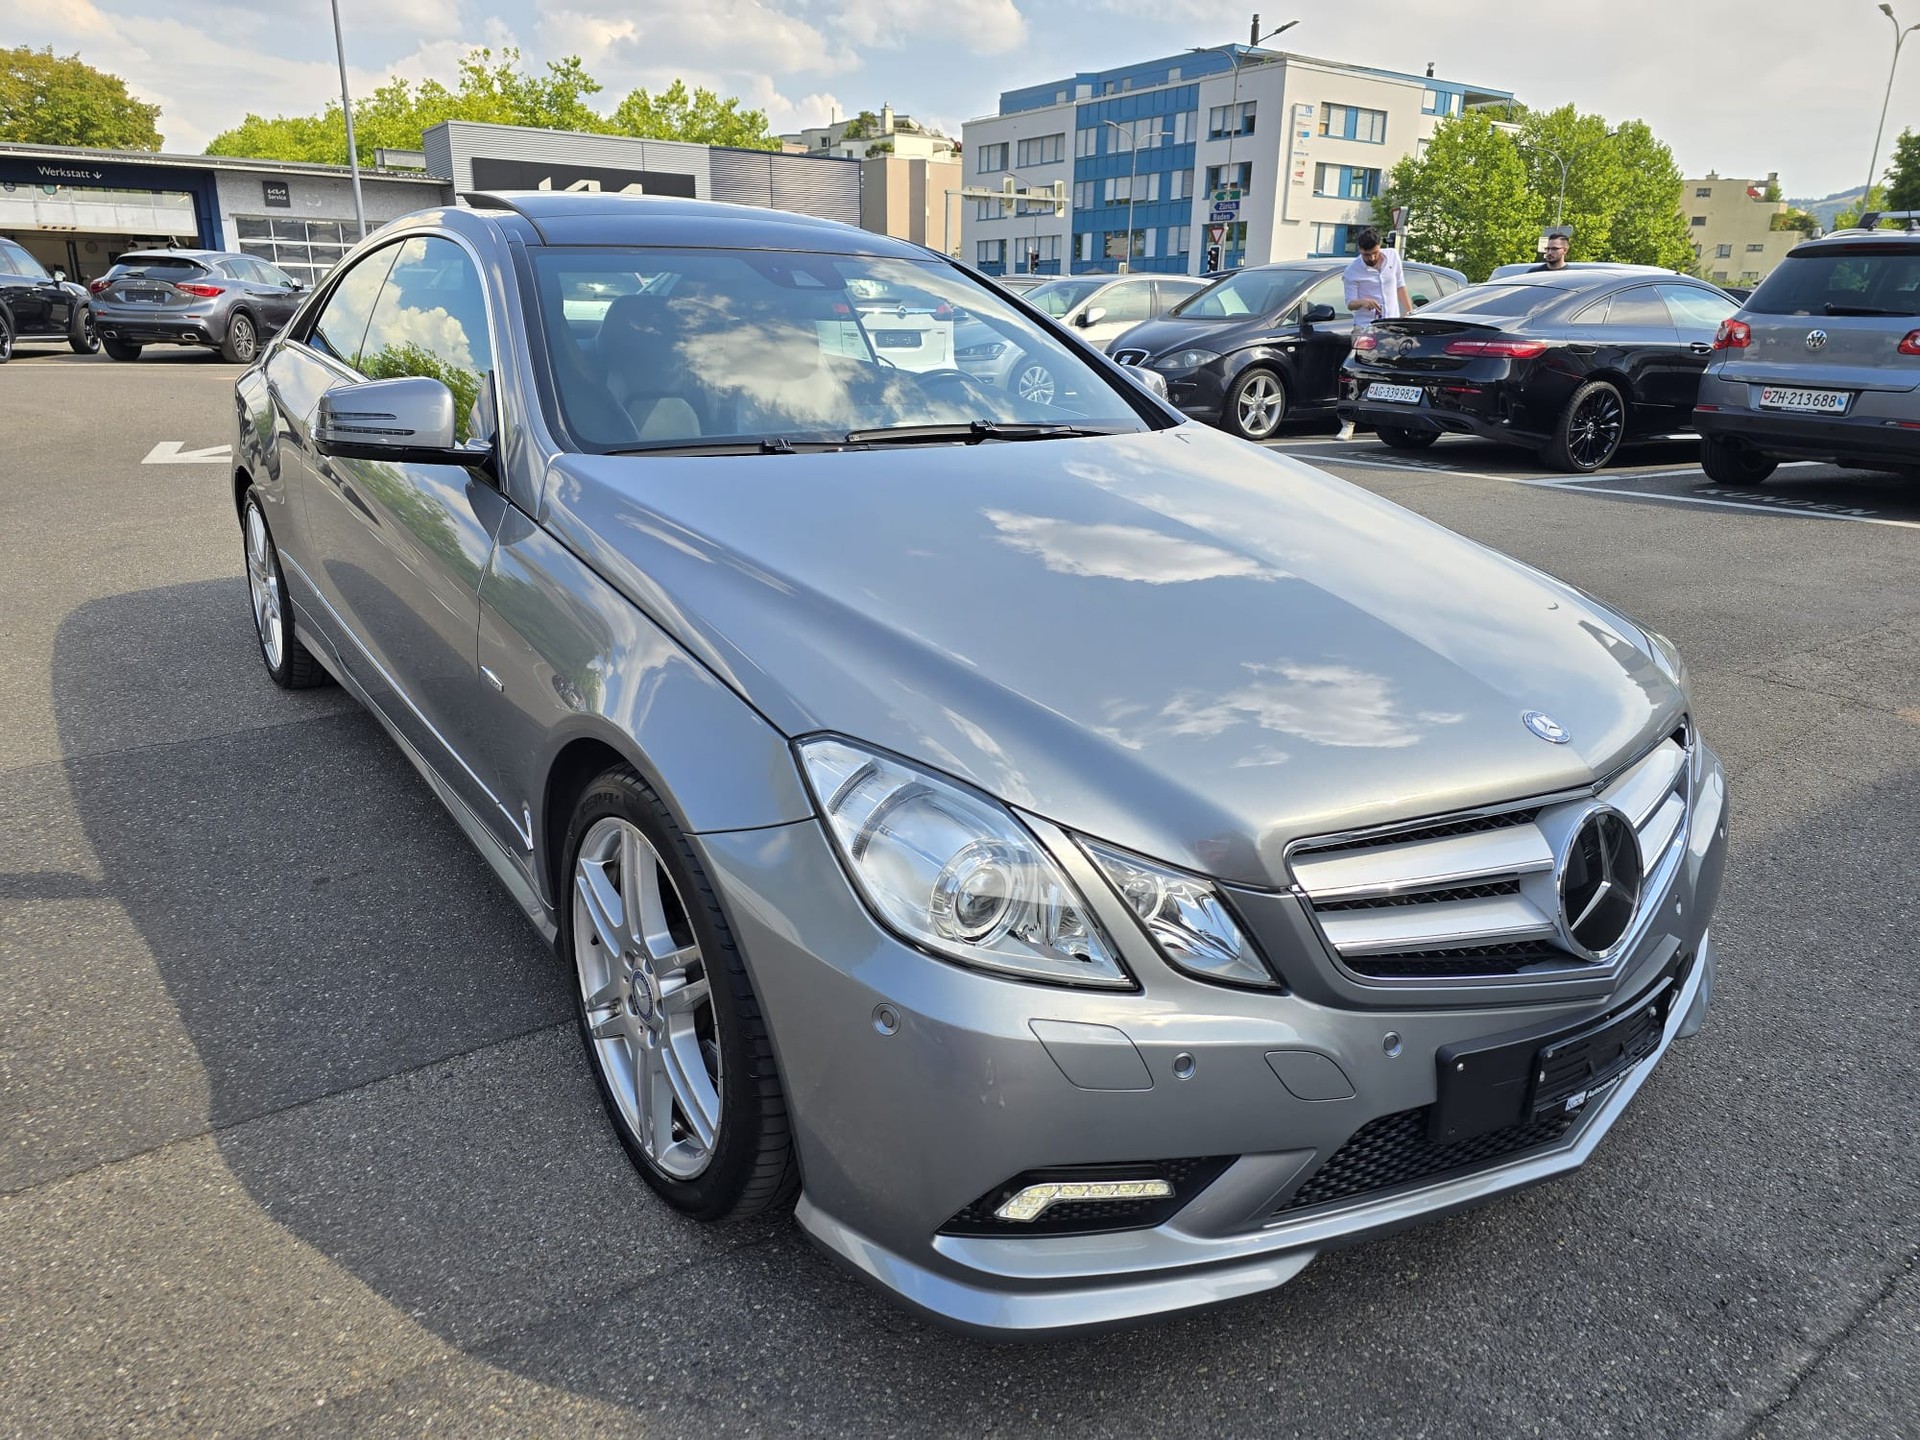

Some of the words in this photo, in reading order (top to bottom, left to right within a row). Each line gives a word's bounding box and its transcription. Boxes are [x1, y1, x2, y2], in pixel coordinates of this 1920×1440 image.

[37, 166, 91, 178] Werkstatt
[1218, 202, 1237, 210] Zürich
[1212, 213, 1231, 221] Baden
